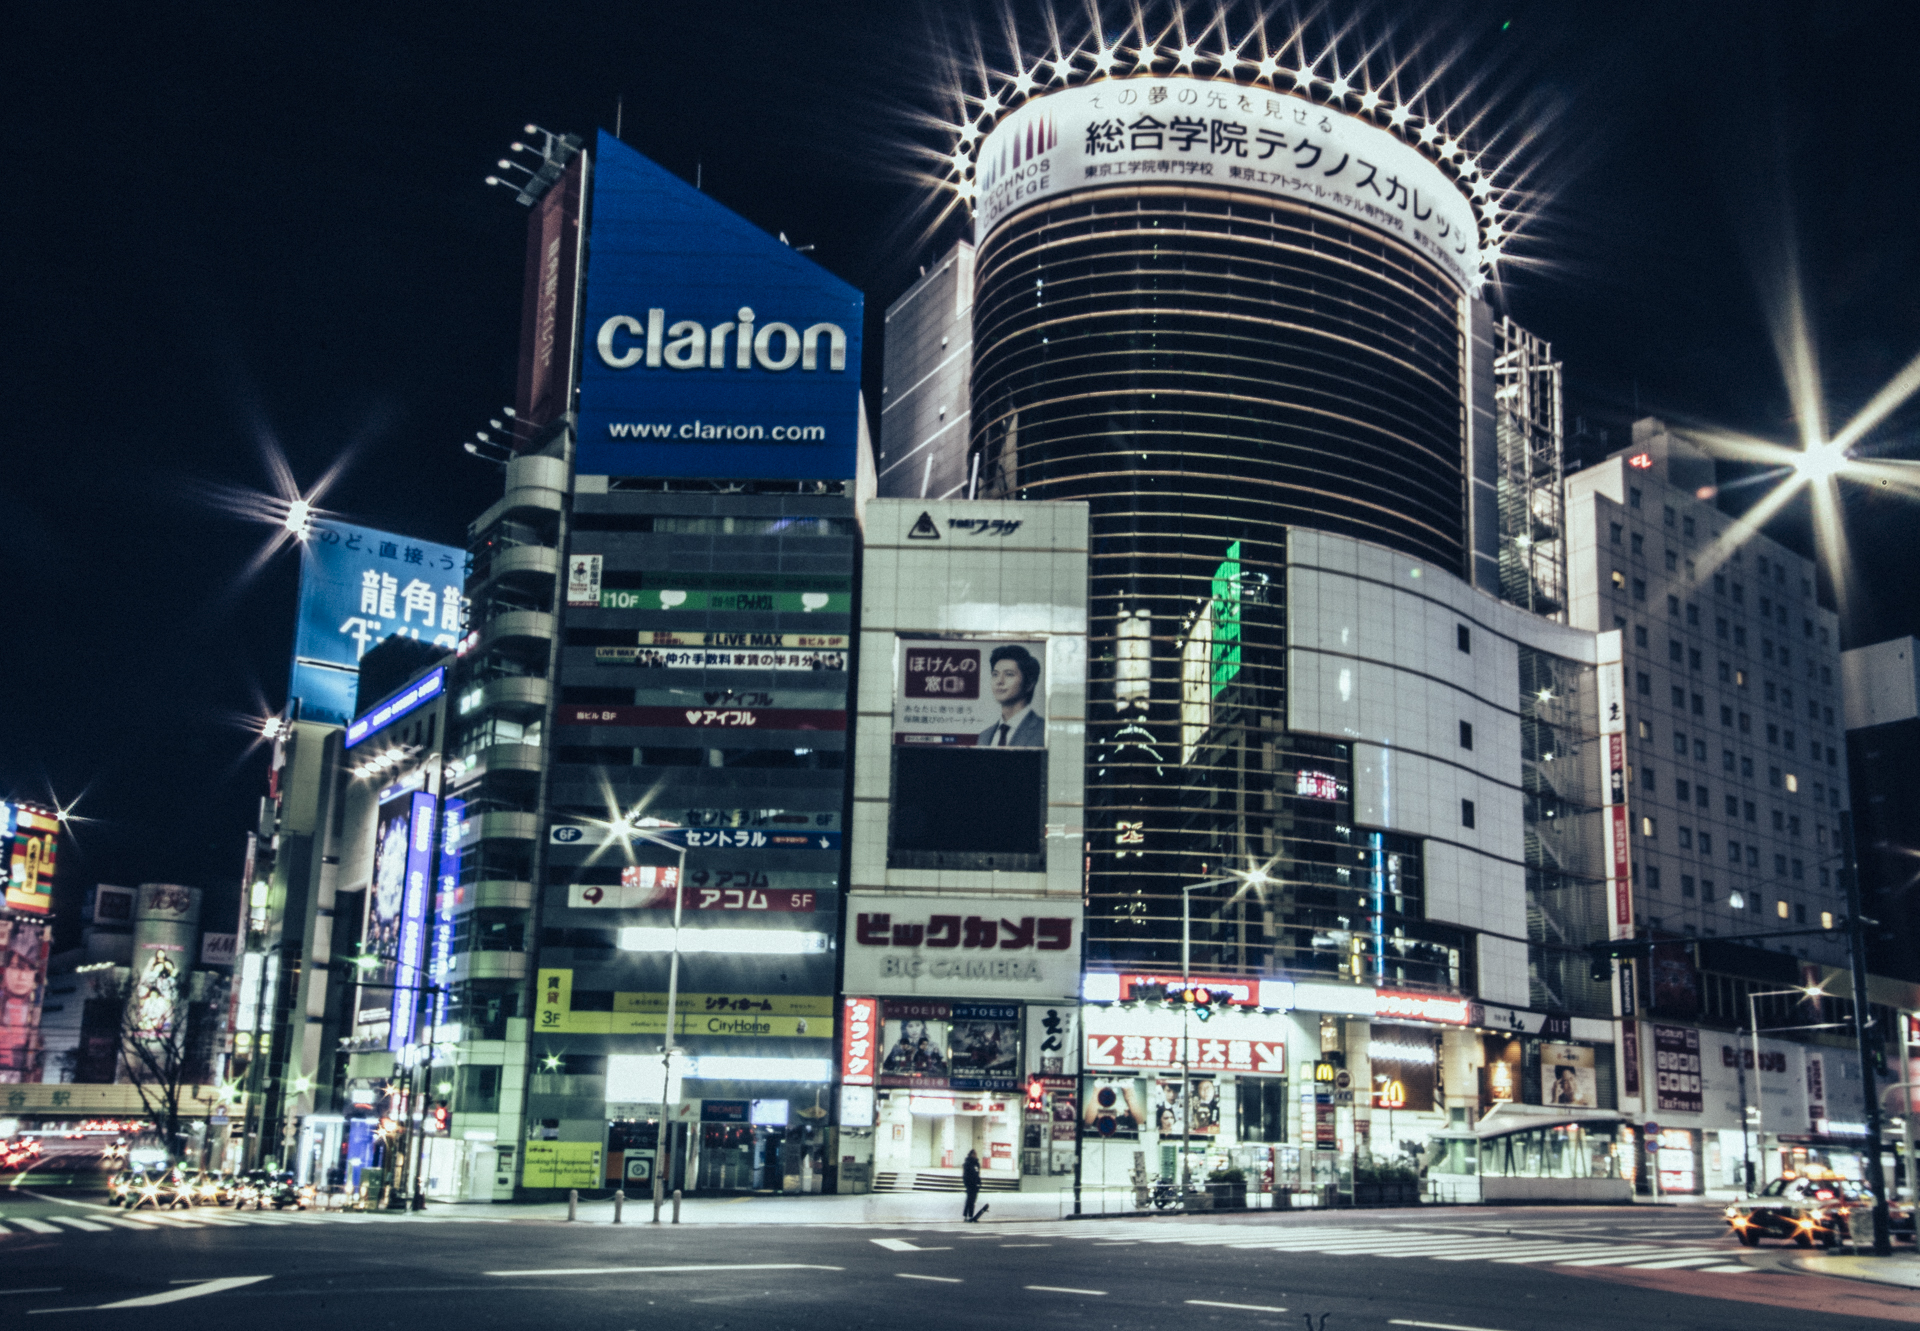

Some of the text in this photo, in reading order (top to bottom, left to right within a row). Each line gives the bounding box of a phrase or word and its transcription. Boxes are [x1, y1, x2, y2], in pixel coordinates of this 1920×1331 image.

[1088, 86, 1333, 135] その夢の先を見せる
[984, 158, 1051, 210] TECHNOS
[1084, 114, 1468, 254] 総合学院テクノスカレッジ
[983, 175, 1051, 229] COLLEGE
[1084, 159, 1214, 180] 東京工学院専門学校
[1228, 165, 1405, 232] 東京エアトラベル・ホテル専門学校
[597, 306, 847, 371] clarion
[608, 420, 826, 441] www.clarion.com
[609, 591, 639, 609] 10F
[750, 634, 784, 647] MAX
[909, 657, 977, 673] ほけんの
[924, 676, 965, 693] 窓口
[703, 711, 757, 726] アイフル
[686, 809, 767, 827] セントラル
[558, 830, 577, 841] 6F
[685, 831, 767, 848] セントラル
[699, 890, 813, 909] アコム 5F
[856, 913, 1074, 951] ビックカメラ
[929, 956, 1044, 982] CAMERA
[541, 1011, 562, 1024] 3F
[707, 1017, 771, 1034] CityHome
[848, 1003, 871, 1075] カラオケ
